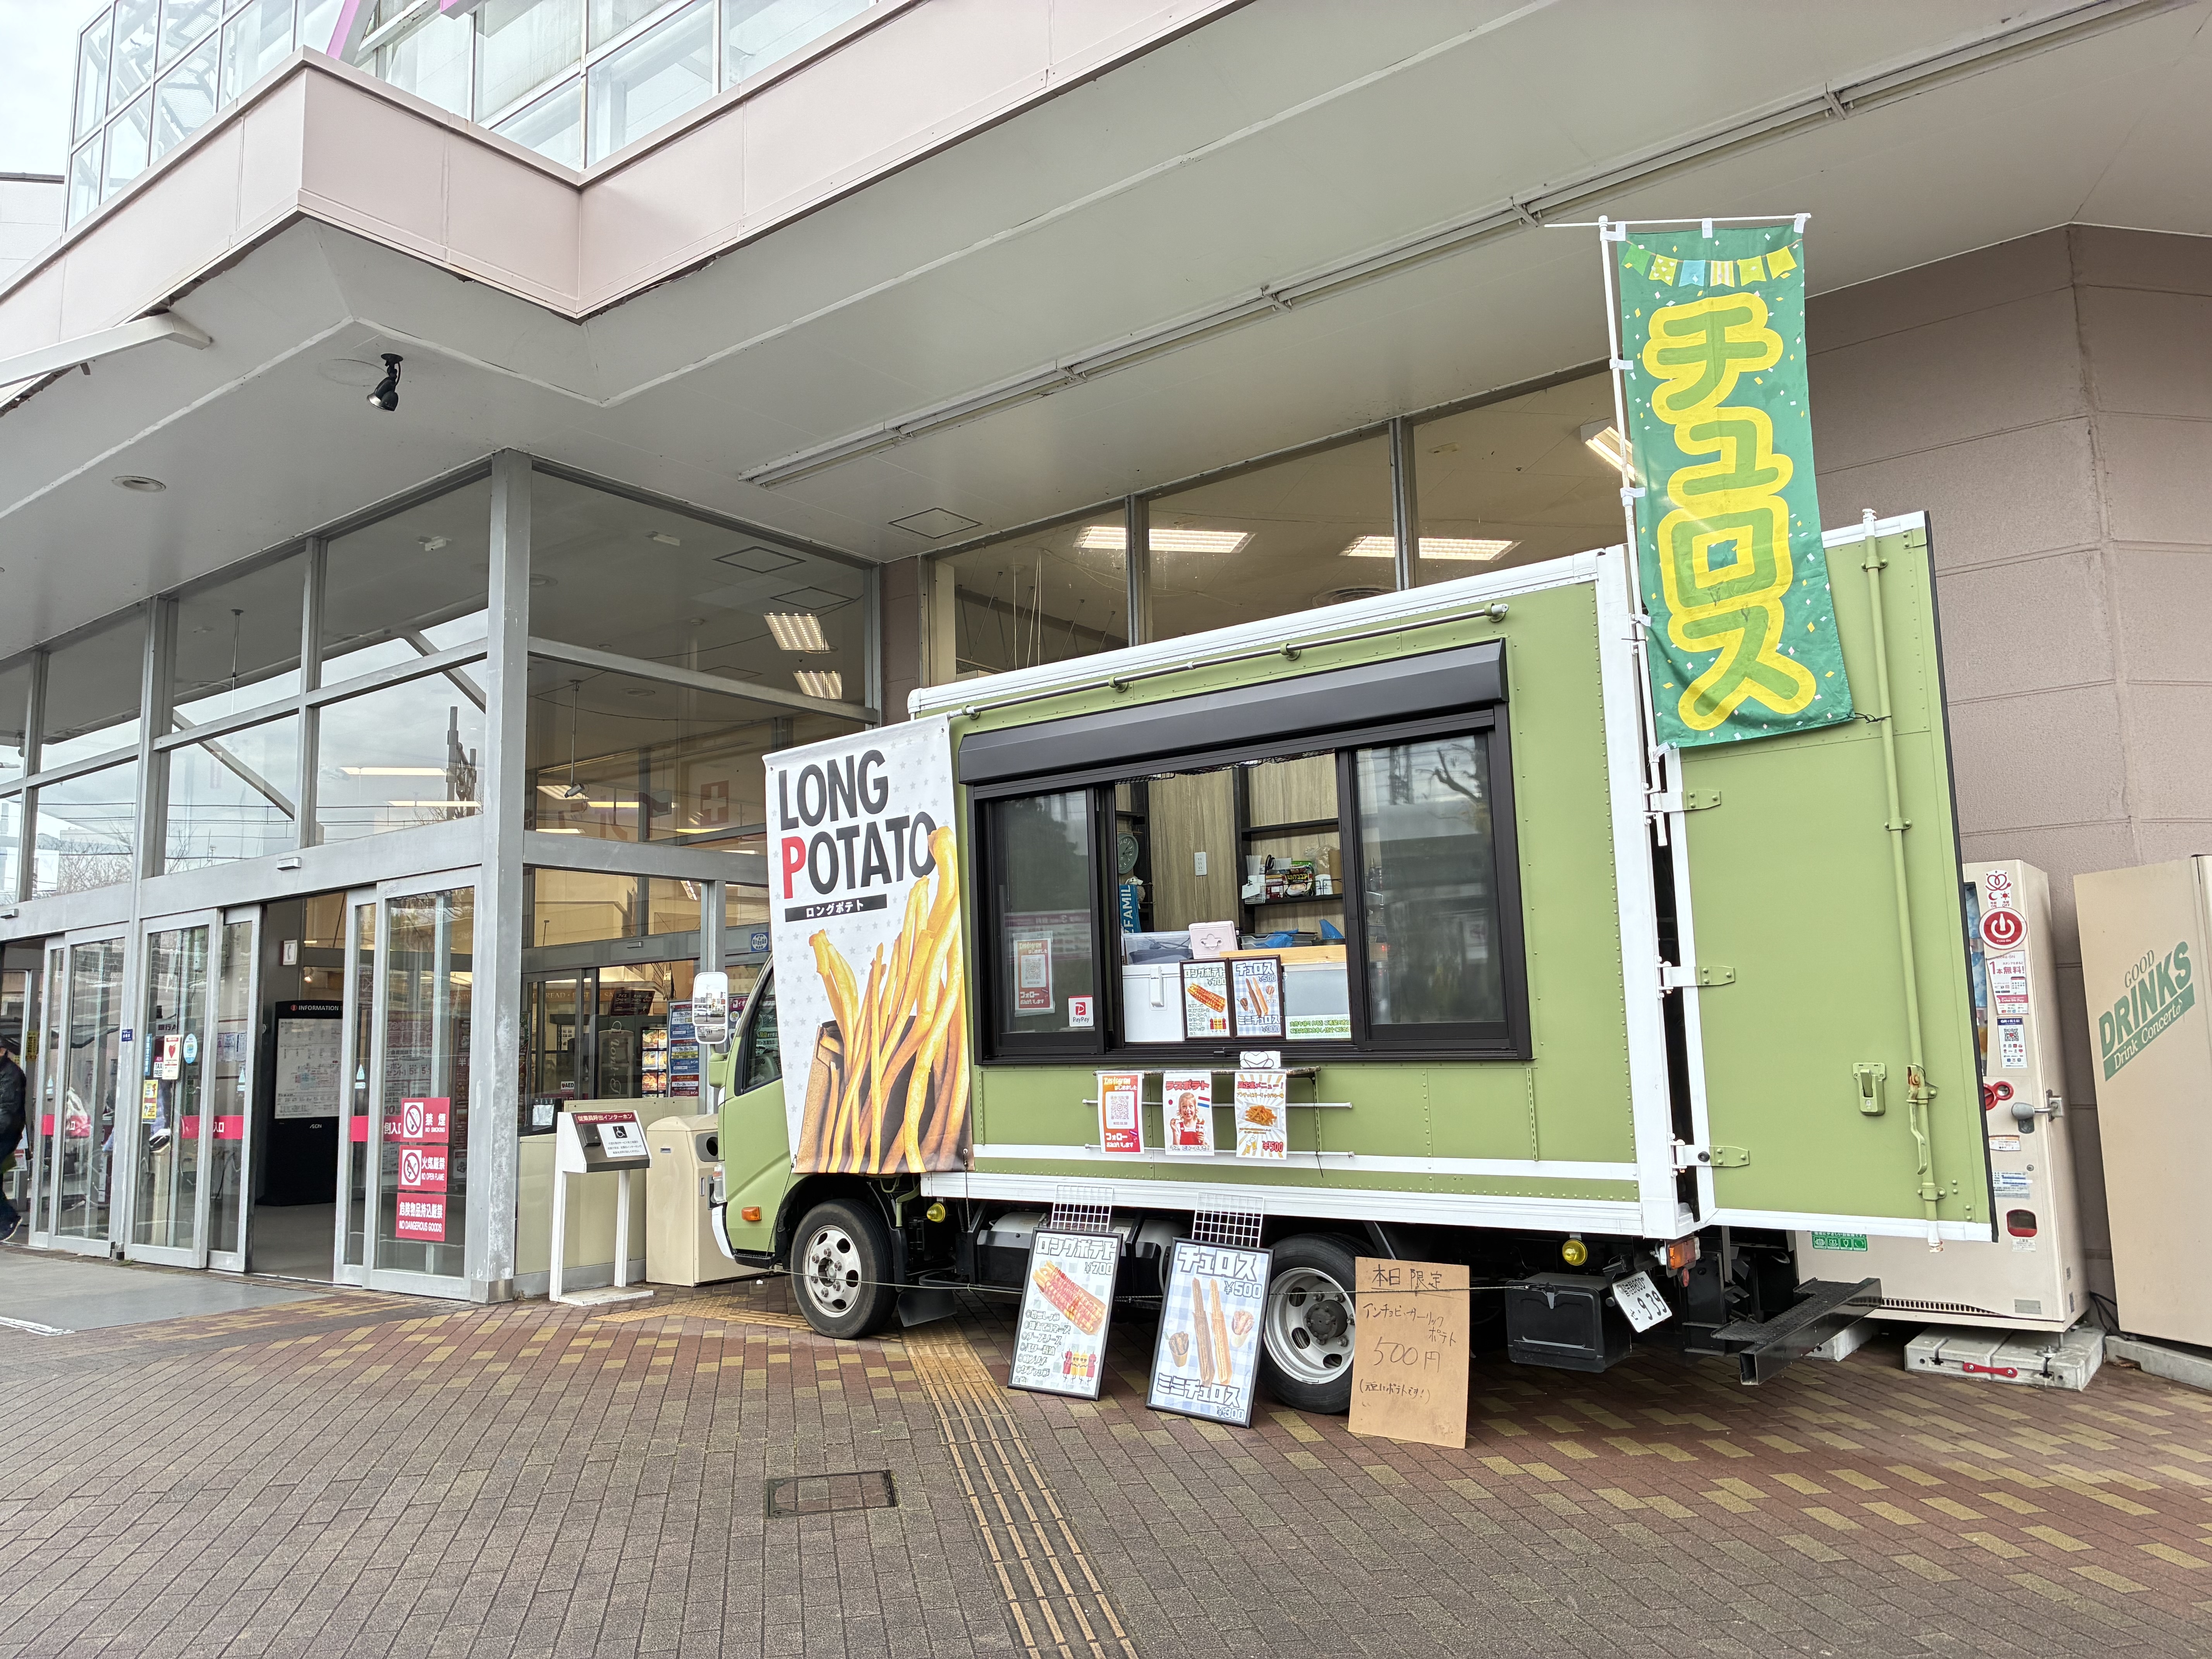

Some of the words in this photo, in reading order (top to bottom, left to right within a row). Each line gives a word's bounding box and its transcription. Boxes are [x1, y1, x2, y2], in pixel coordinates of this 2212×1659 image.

[1643, 293, 1815, 731] チュロス
[778, 749, 889, 831] LONG
[781, 811, 937, 899] POTATO
[806, 899, 864, 917] ロングポテト
[1184, 967, 1226, 978] ロングポテト
[2124, 950, 2155, 988] GOOD
[2099, 941, 2191, 1060] DRINKS
[2114, 1039, 2138, 1070] Drink
[1165, 1079, 1210, 1091] ラスポテト
[577, 1114, 632, 1122] 従業員呼出インターホン
[1106, 1132, 1128, 1140] フォロー
[1262, 1140, 1284, 1152] ¥500
[422, 1156, 445, 1170] 火気厳禁
[399, 1201, 443, 1219] 危険物品持込厳禁
[399, 1220, 405, 1229] NO
[405, 1221, 428, 1231] DANGEROUS
[428, 1223, 442, 1233] GOODS
[1036, 1236, 1117, 1260] ロングポテト
[1084, 1261, 1114, 1275] ¥700
[1177, 1245, 1257, 1282] チュロス
[1224, 1281, 1262, 1299] ¥500
[1429, 1326, 1456, 1346] ポテト
[1373, 1336, 1440, 1373] 500円
[1156, 1372, 1240, 1408] ミニチュロス
[1217, 1406, 1245, 1421] ¥300
